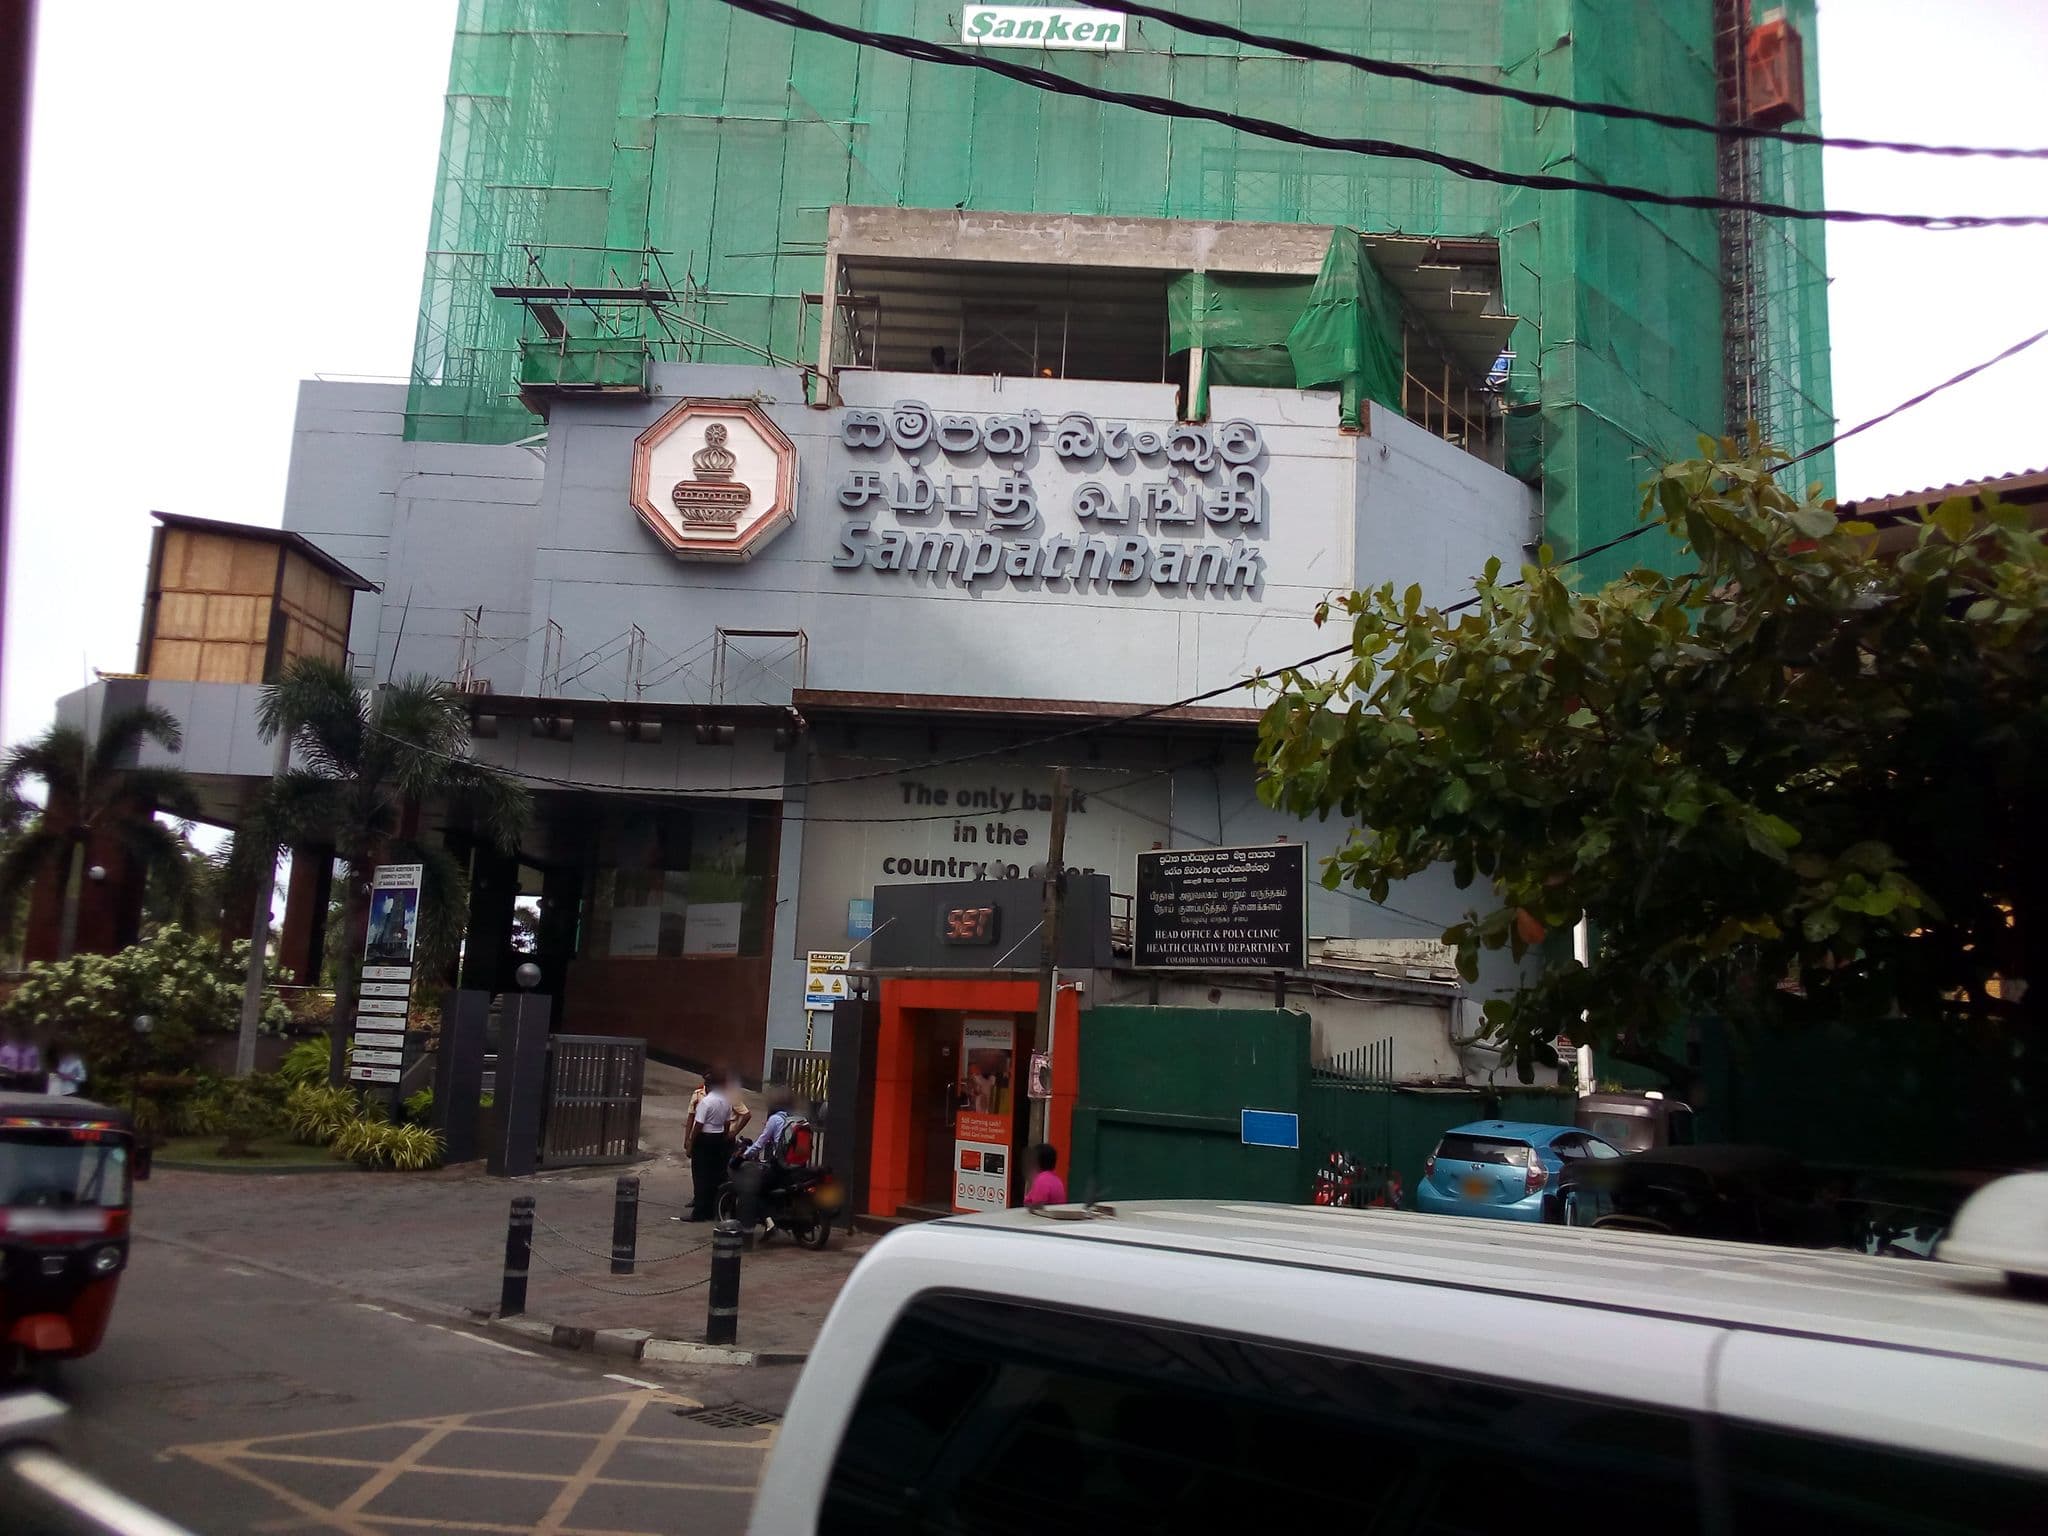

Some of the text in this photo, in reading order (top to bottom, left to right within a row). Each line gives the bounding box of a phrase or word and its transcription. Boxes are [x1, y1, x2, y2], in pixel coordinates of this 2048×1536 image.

[967, 12, 1121, 43] Sanken
[838, 457, 1262, 532] சம்பத் வங்கி
[900, 782, 1087, 814] The only bak
[953, 820, 1029, 846] in the
[1146, 942, 1291, 953] HEALTH CURATIVE DEPARTMENT
[1155, 929, 1281, 939] HEAD OFFICE & POLY CLINIC
